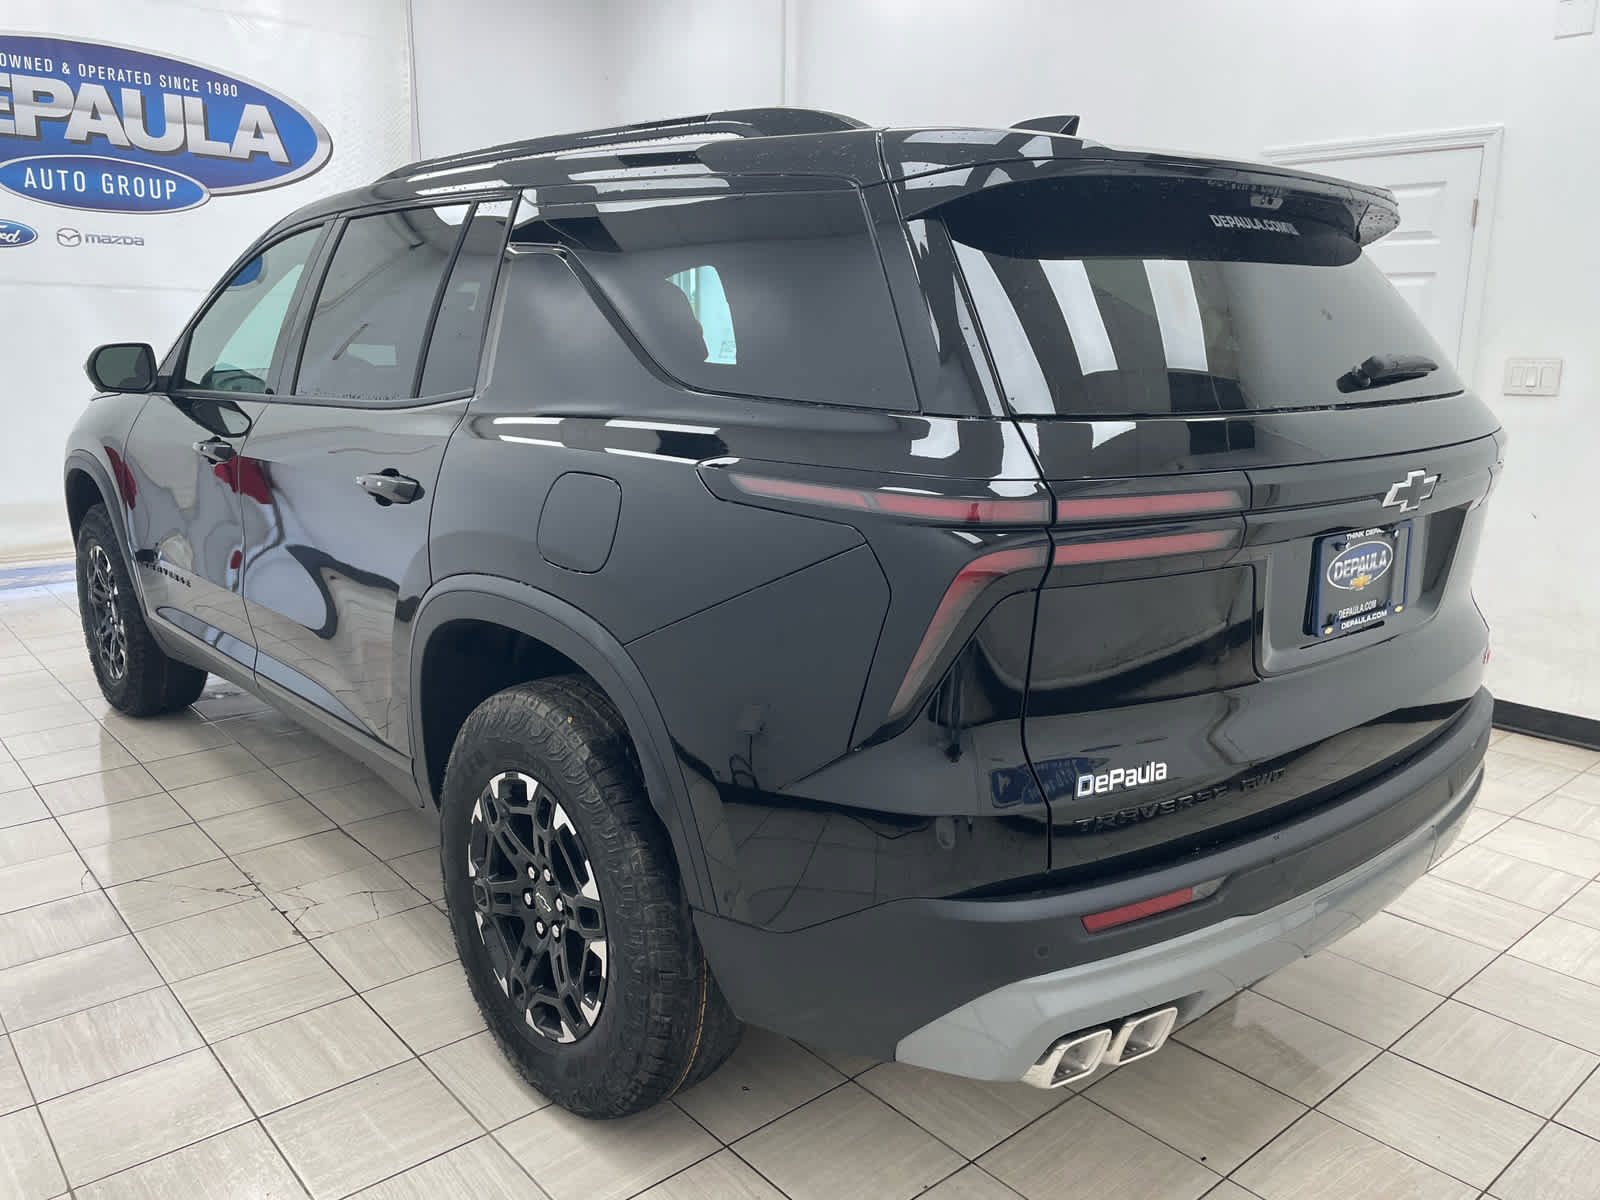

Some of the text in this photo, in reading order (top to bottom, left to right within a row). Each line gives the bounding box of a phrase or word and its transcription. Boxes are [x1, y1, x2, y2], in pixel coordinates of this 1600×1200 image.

[0, 52, 238, 97] OWNED & OPERATED SINCE 1980
[0, 73, 290, 165] PAULA
[24, 167, 177, 200] AUTO GROUP
[86, 233, 145, 246] mazda
[1334, 550, 1387, 581] DEPAULA
[1338, 600, 1377, 619] DEPAULA.COM
[1341, 610, 1388, 630] DEPAULA.COM
[1077, 761, 1168, 797] DePaula
[1073, 785, 1230, 833] TRAVERSE
